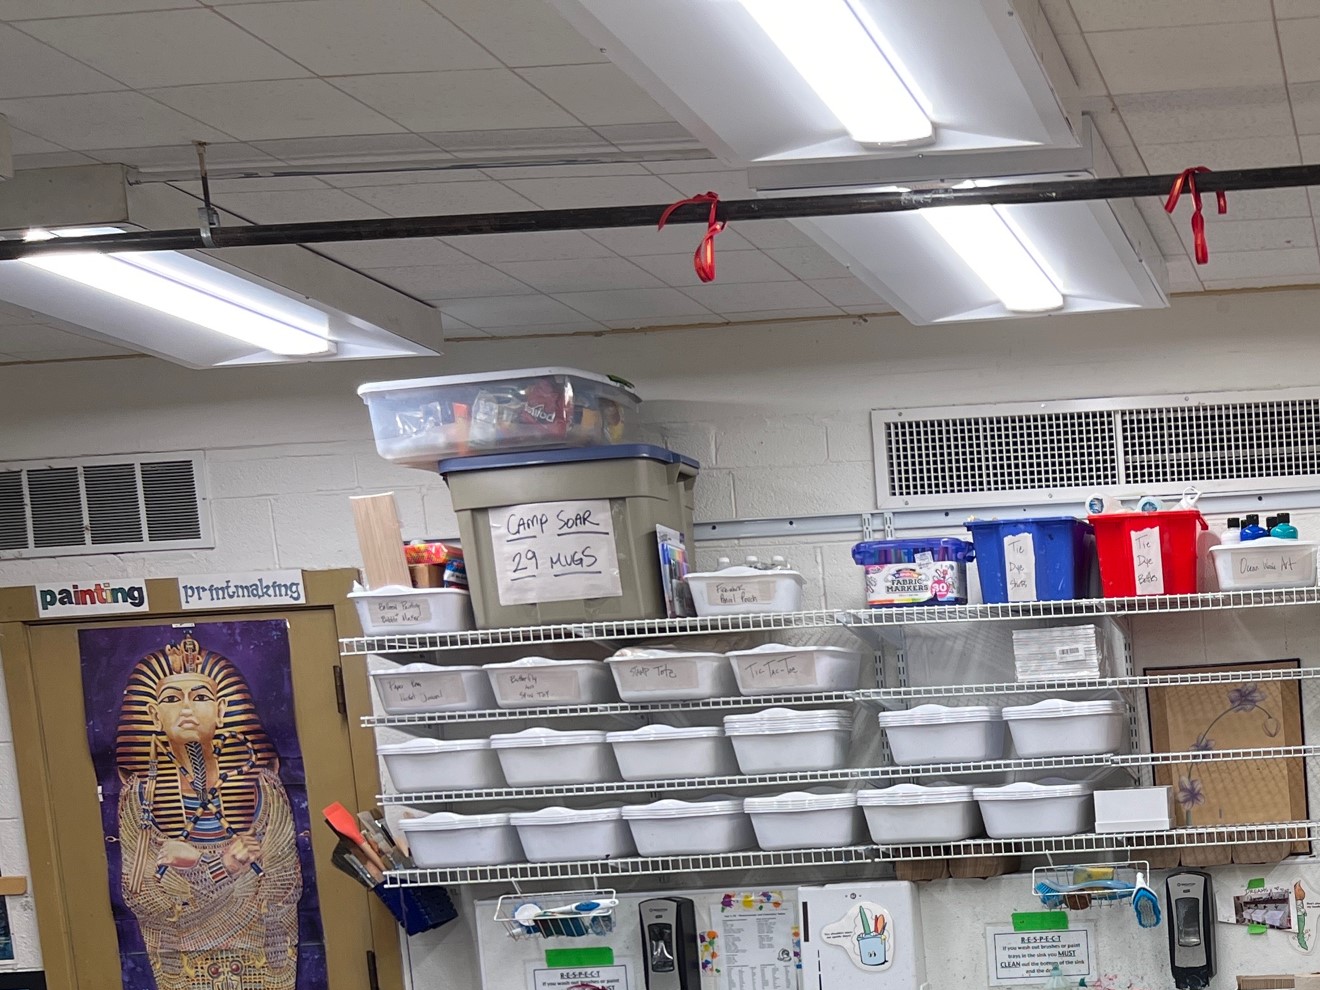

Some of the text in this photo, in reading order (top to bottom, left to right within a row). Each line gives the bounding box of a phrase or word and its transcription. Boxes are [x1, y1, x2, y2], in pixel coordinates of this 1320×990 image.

[506, 509, 600, 536] CAMP SOAR
[1008, 539, 1025, 553] Tie
[1135, 534, 1152, 549] Tie
[512, 546, 598, 574] 29 MUGS
[1137, 554, 1154, 567] Dye
[1280, 556, 1297, 572] Art
[1009, 562, 1025, 575] Dye
[181, 578, 302, 605] printmaking
[886, 585, 929, 593] MARKERS
[932, 583, 948, 591] 30
[39, 582, 145, 611] painting
